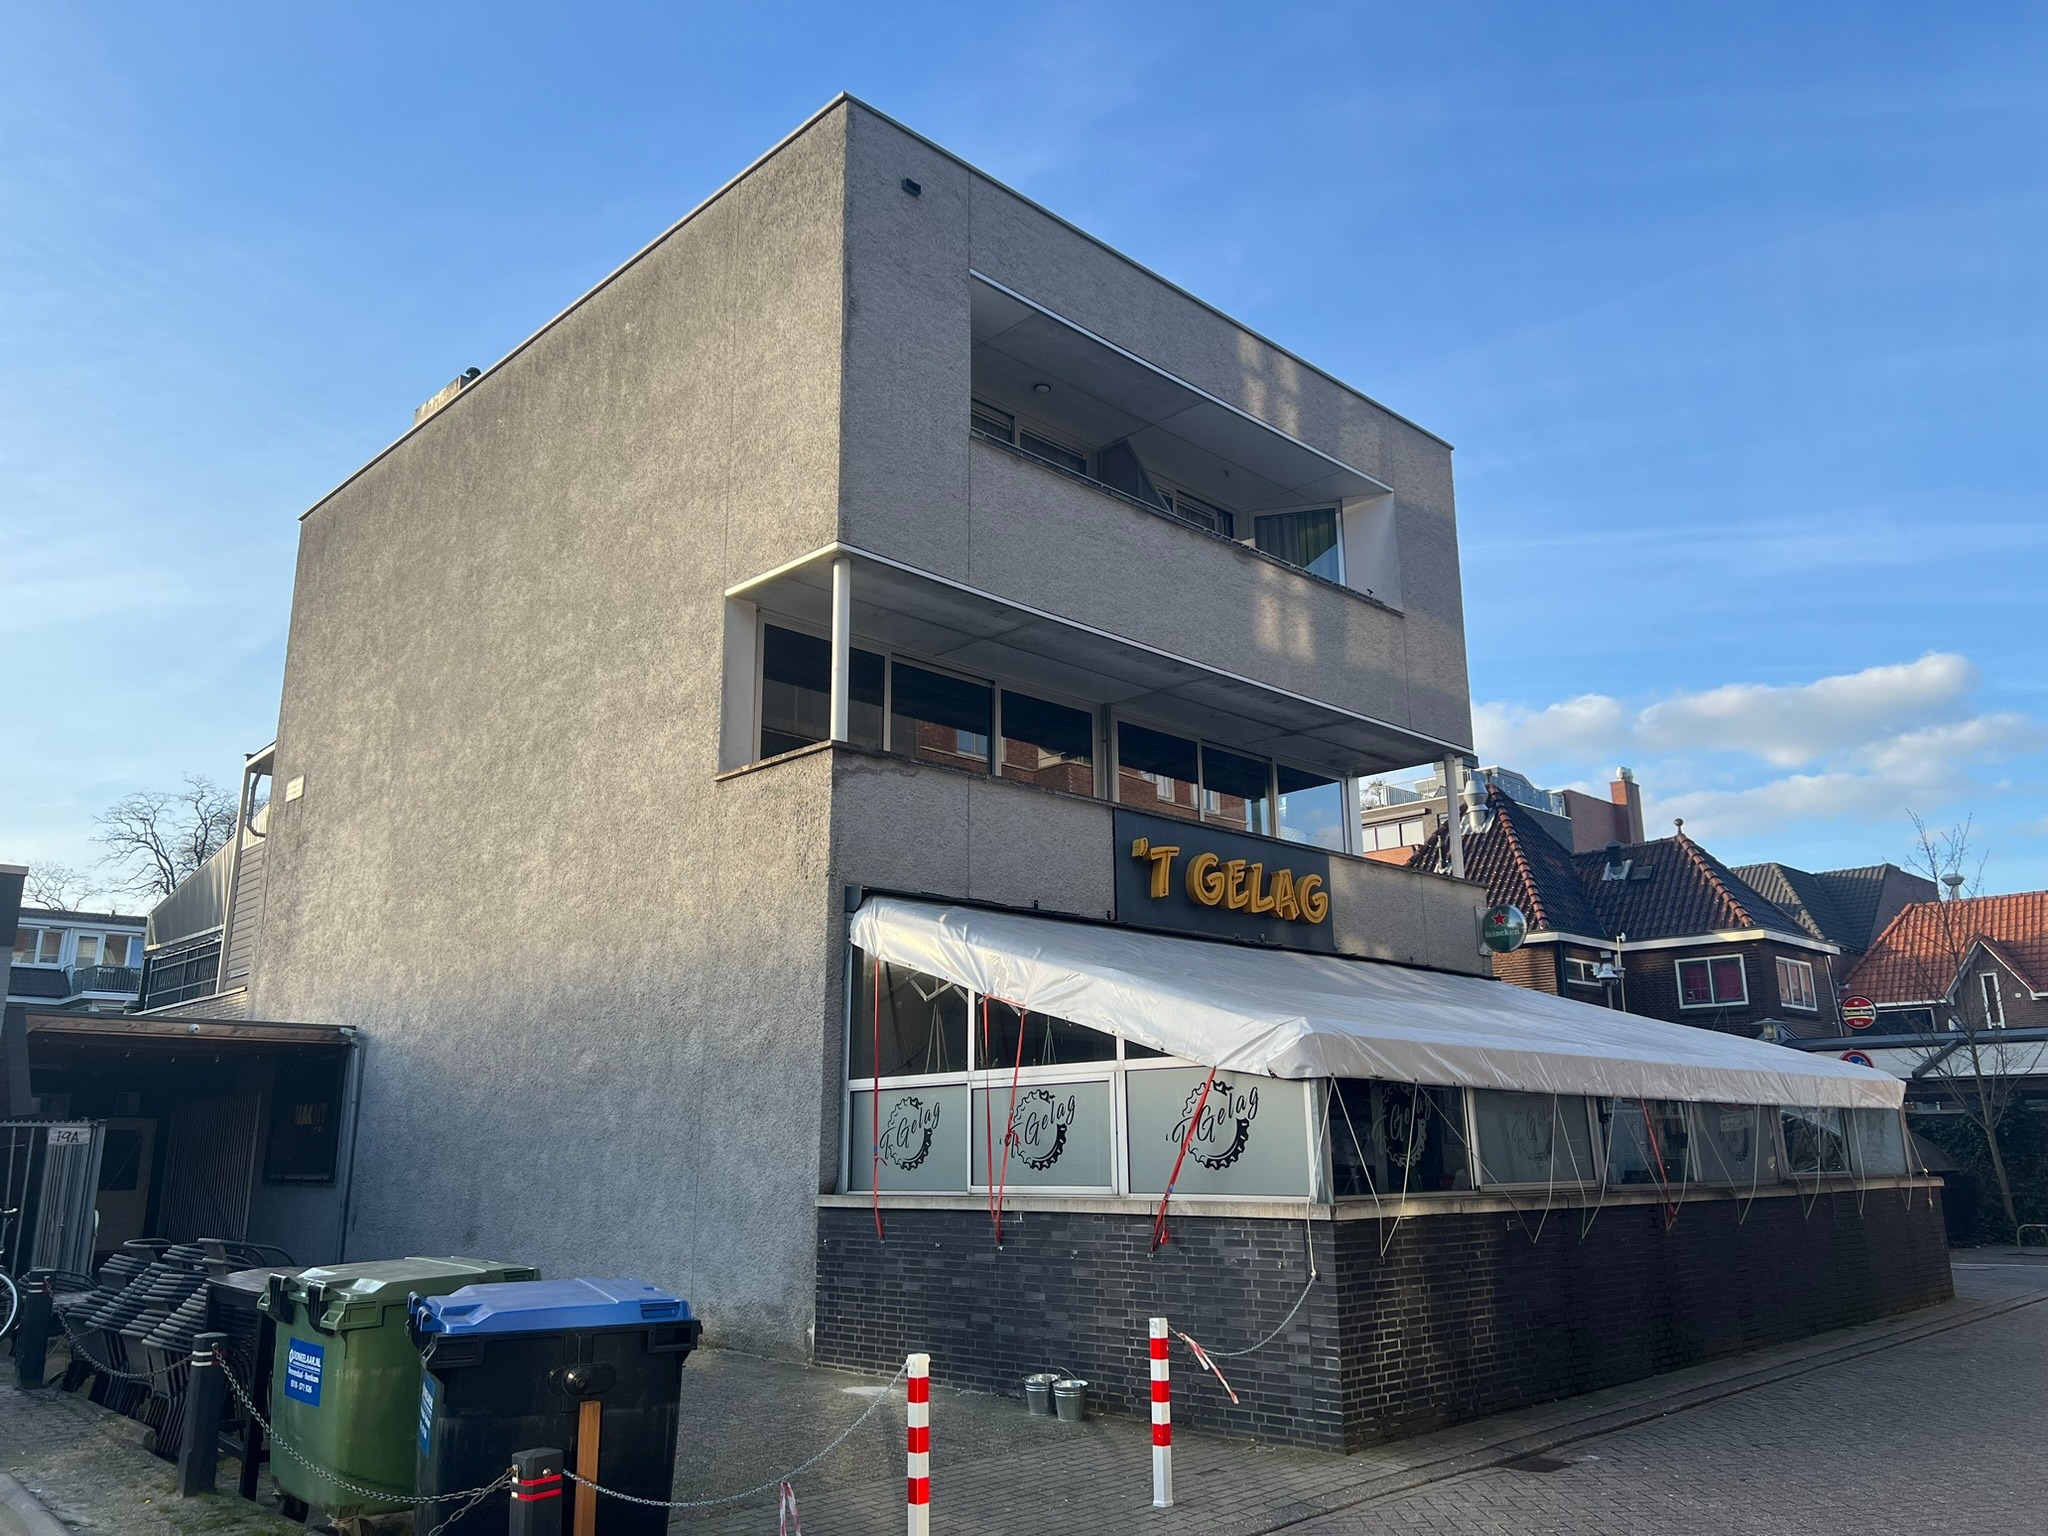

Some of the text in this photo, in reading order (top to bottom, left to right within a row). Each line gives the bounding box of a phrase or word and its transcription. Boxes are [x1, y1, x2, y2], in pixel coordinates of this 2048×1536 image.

[1185, 852, 1328, 924] GELAG
[56, 1131, 79, 1143] 19A
[897, 1101, 940, 1148] Gelag
[1025, 1095, 1075, 1146] Gelag
[1197, 1086, 1259, 1143] Gelag
